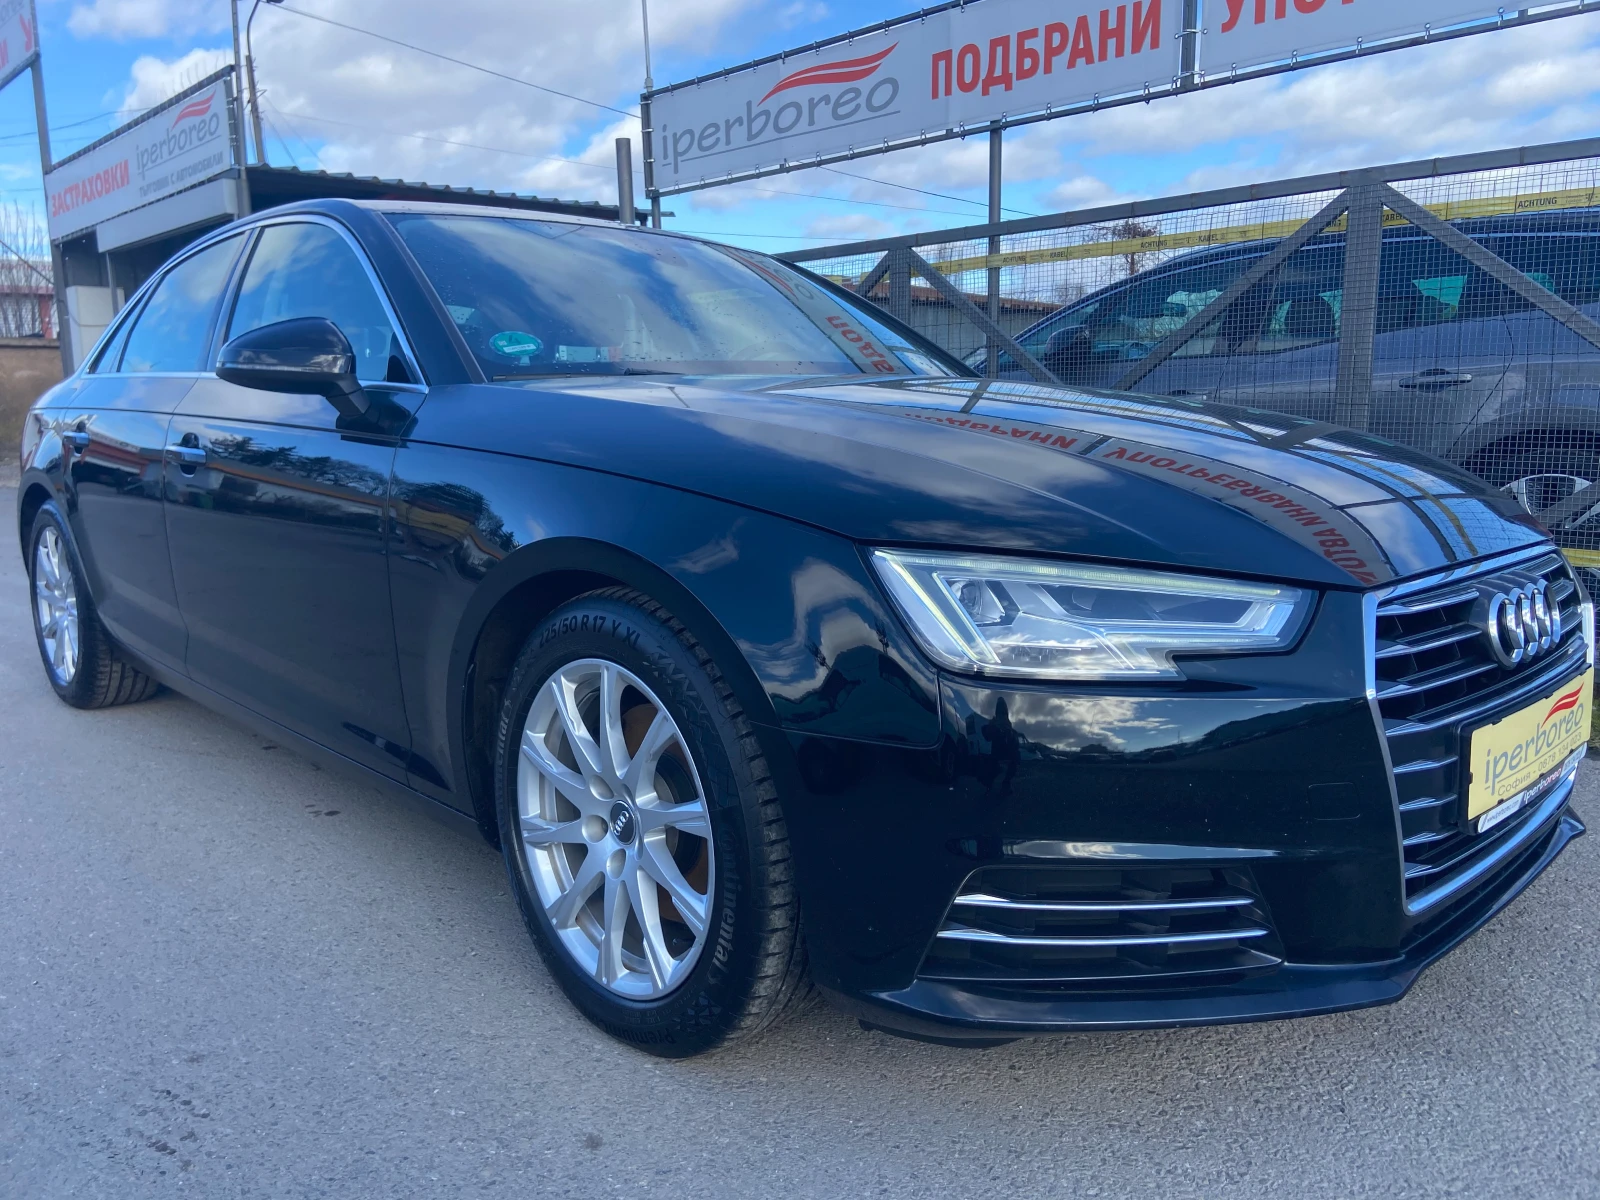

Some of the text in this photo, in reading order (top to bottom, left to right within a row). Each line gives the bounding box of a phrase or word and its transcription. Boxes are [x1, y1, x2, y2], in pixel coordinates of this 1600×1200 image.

[931, 0, 1162, 100] ПОДБРАНИ
[136, 112, 220, 181] iperboreo
[661, 77, 900, 174] iperboreo
[52, 159, 130, 217] ЗАСТРАХОВКИ
[1517, 197, 1558, 208] ACHTUNG
[1002, 255, 1026, 264] ACHTUNG
[1140, 239, 1168, 248] ACHTUNG
[1485, 703, 1584, 796] iperboreo
[1497, 771, 1531, 797] София
[1523, 768, 1561, 804] iperboreo
